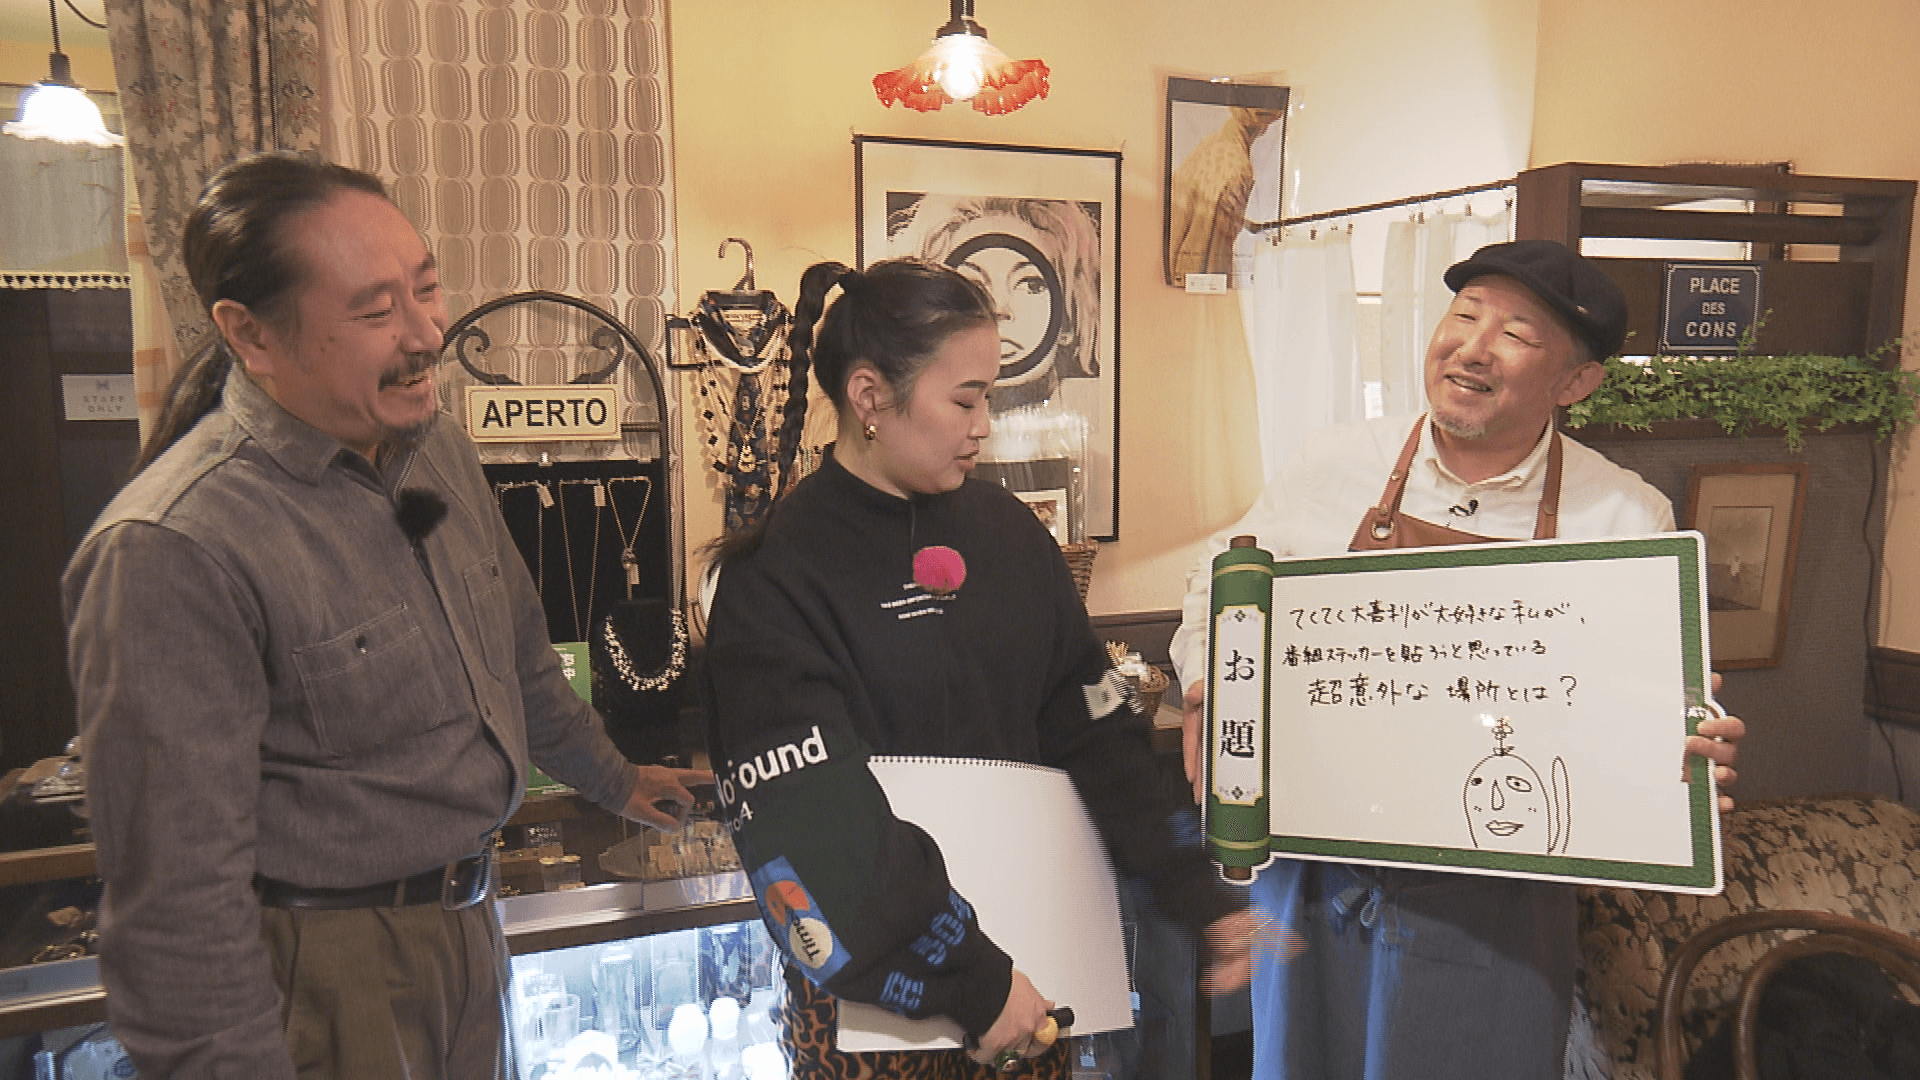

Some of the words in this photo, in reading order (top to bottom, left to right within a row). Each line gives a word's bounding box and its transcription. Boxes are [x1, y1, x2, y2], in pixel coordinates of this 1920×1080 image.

[1689, 277, 1740, 294] PLACE
[1701, 301, 1726, 315] DES
[1685, 321, 1737, 338] CONS
[481, 398, 607, 429] APERTO
[1219, 649, 1256, 759] お題
